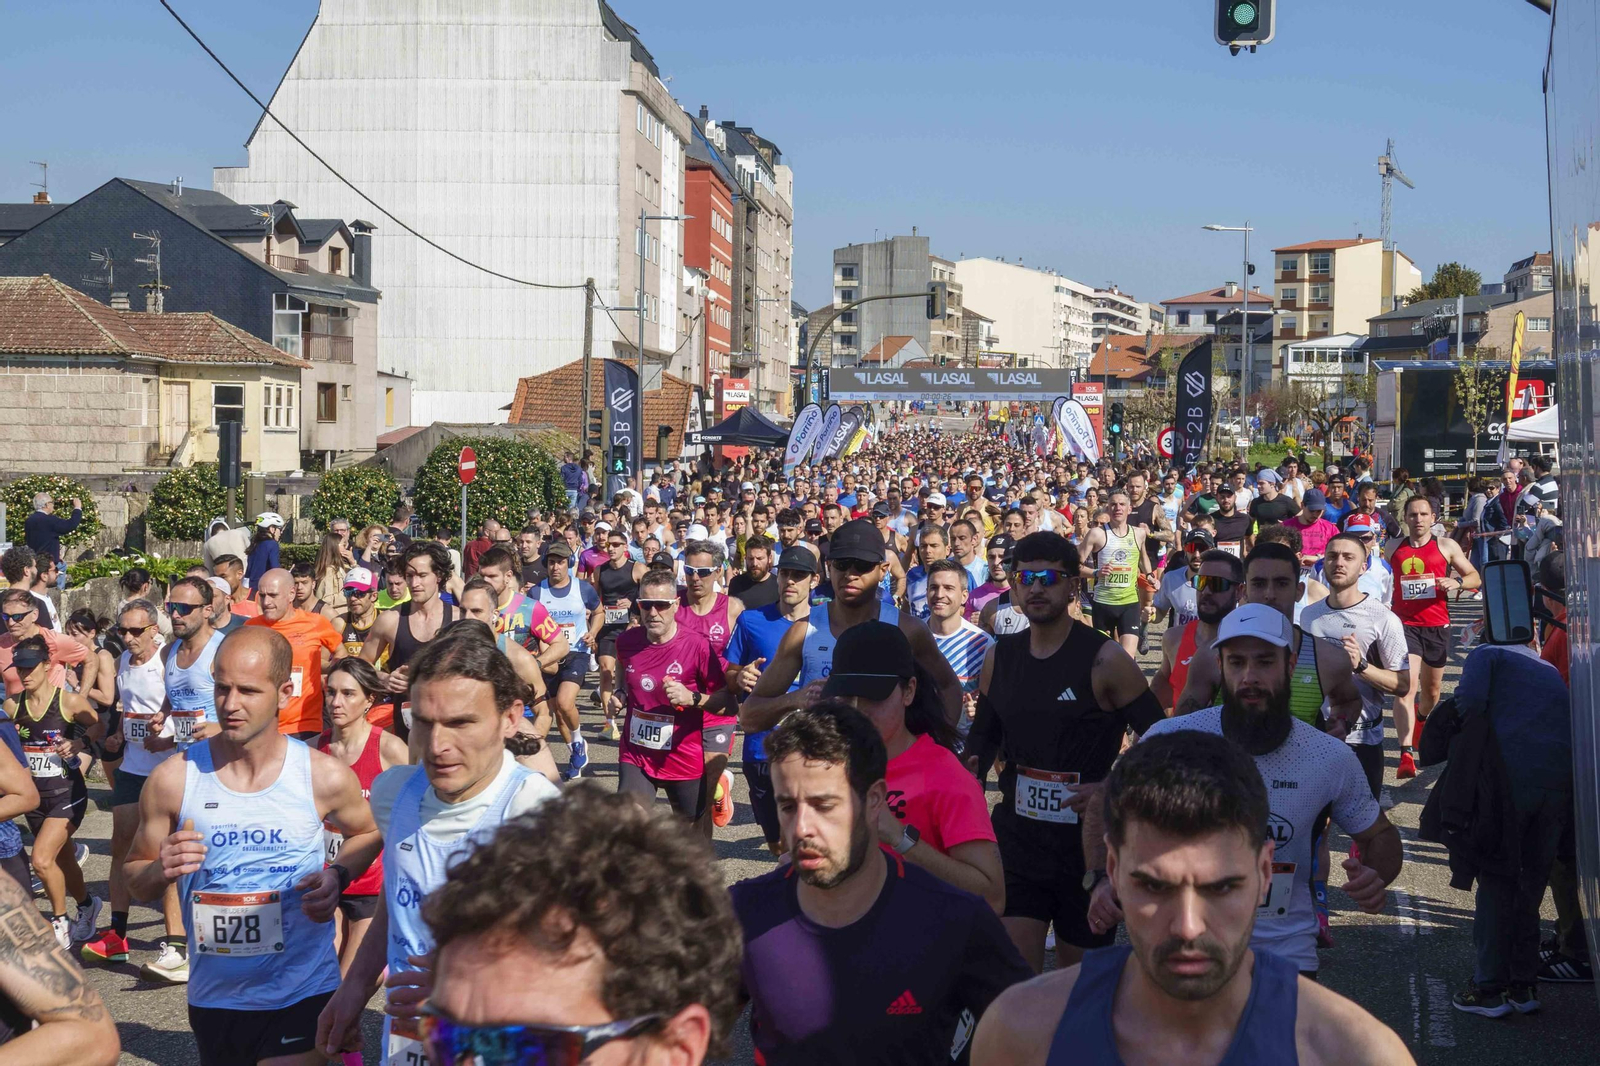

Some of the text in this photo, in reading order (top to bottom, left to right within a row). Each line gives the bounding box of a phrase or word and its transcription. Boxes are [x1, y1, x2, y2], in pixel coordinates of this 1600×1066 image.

[867, 373, 909, 385] LASAL
[933, 373, 975, 385] LASAL
[1000, 373, 1042, 385] LASAL
[795, 410, 818, 445] Porriño
[830, 421, 854, 452] LASAL
[1109, 573, 1129, 584] 2206
[1408, 582, 1428, 595] 952
[610, 611, 623, 620] 742
[637, 723, 662, 743] 409
[29, 756, 51, 771] 374
[1027, 785, 1062, 812] 355
[269, 865, 298, 873] GADIS
[213, 914, 261, 944] 628
[886, 1006, 923, 1015] adidas
